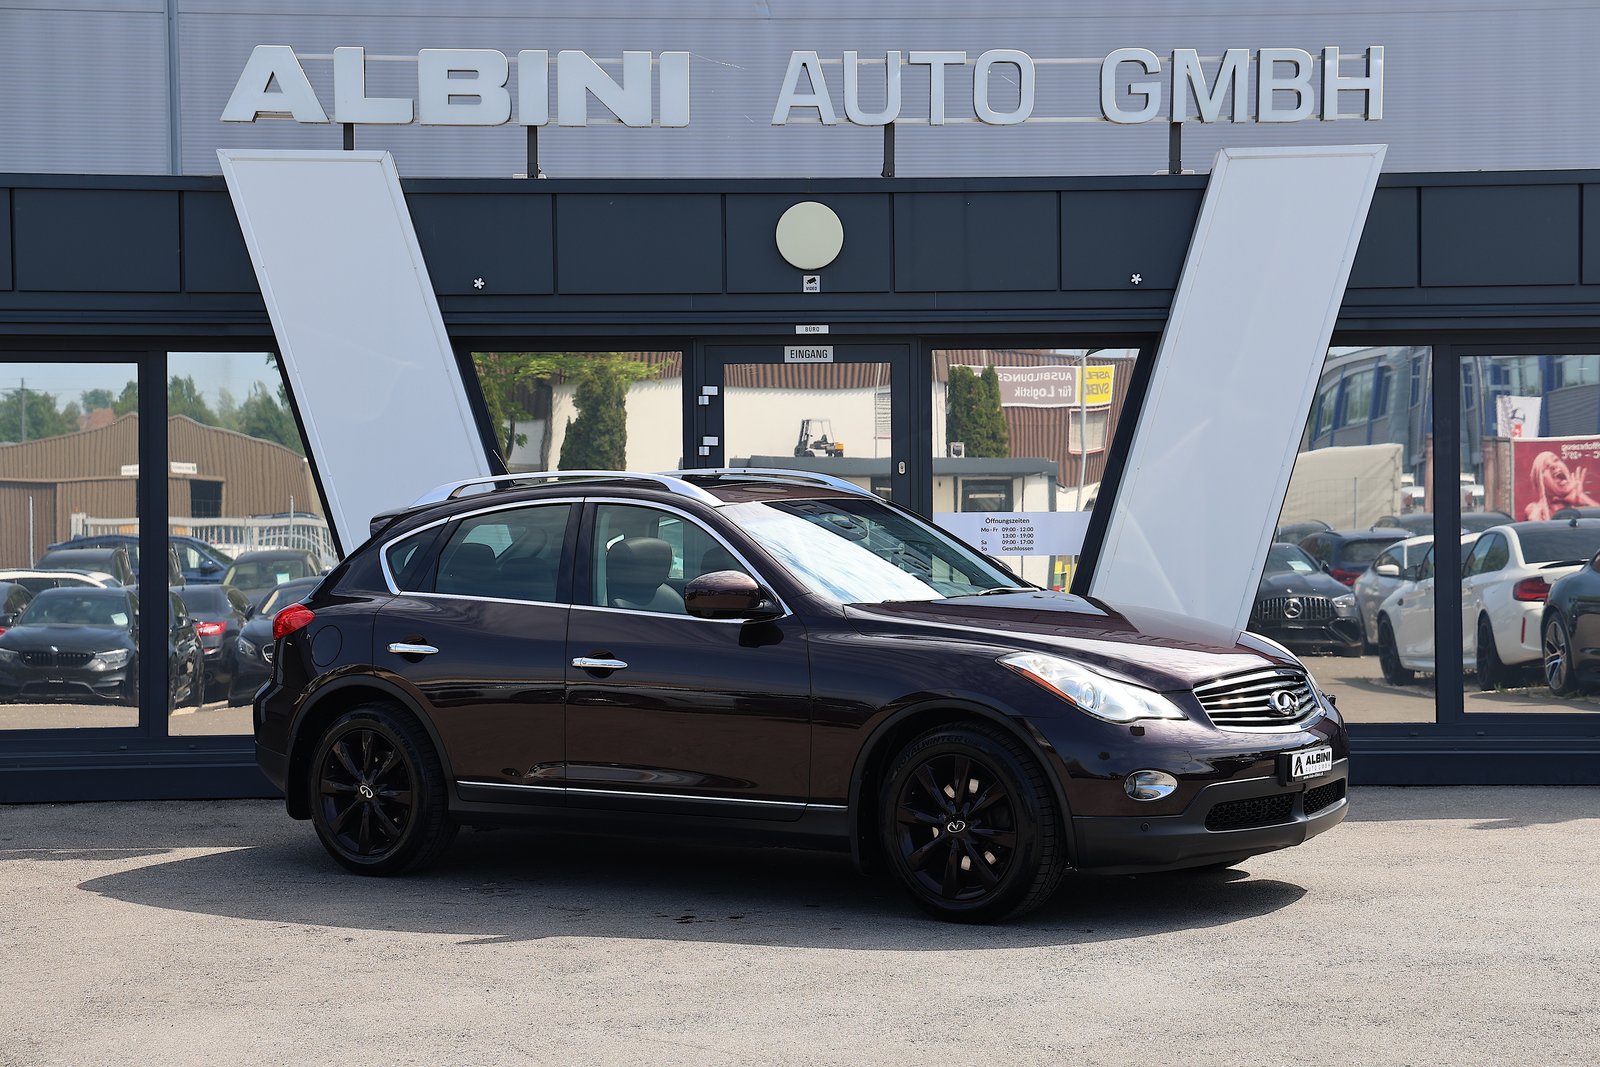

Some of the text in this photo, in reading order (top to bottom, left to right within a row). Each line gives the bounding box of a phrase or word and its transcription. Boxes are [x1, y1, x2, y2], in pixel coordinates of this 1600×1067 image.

[220, 45, 1385, 127] ALBINI AUTO GMBH
[790, 349, 828, 359] EINGANG
[985, 517, 1030, 525] Öffnungszeiten
[1305, 751, 1331, 766] ALBINI
